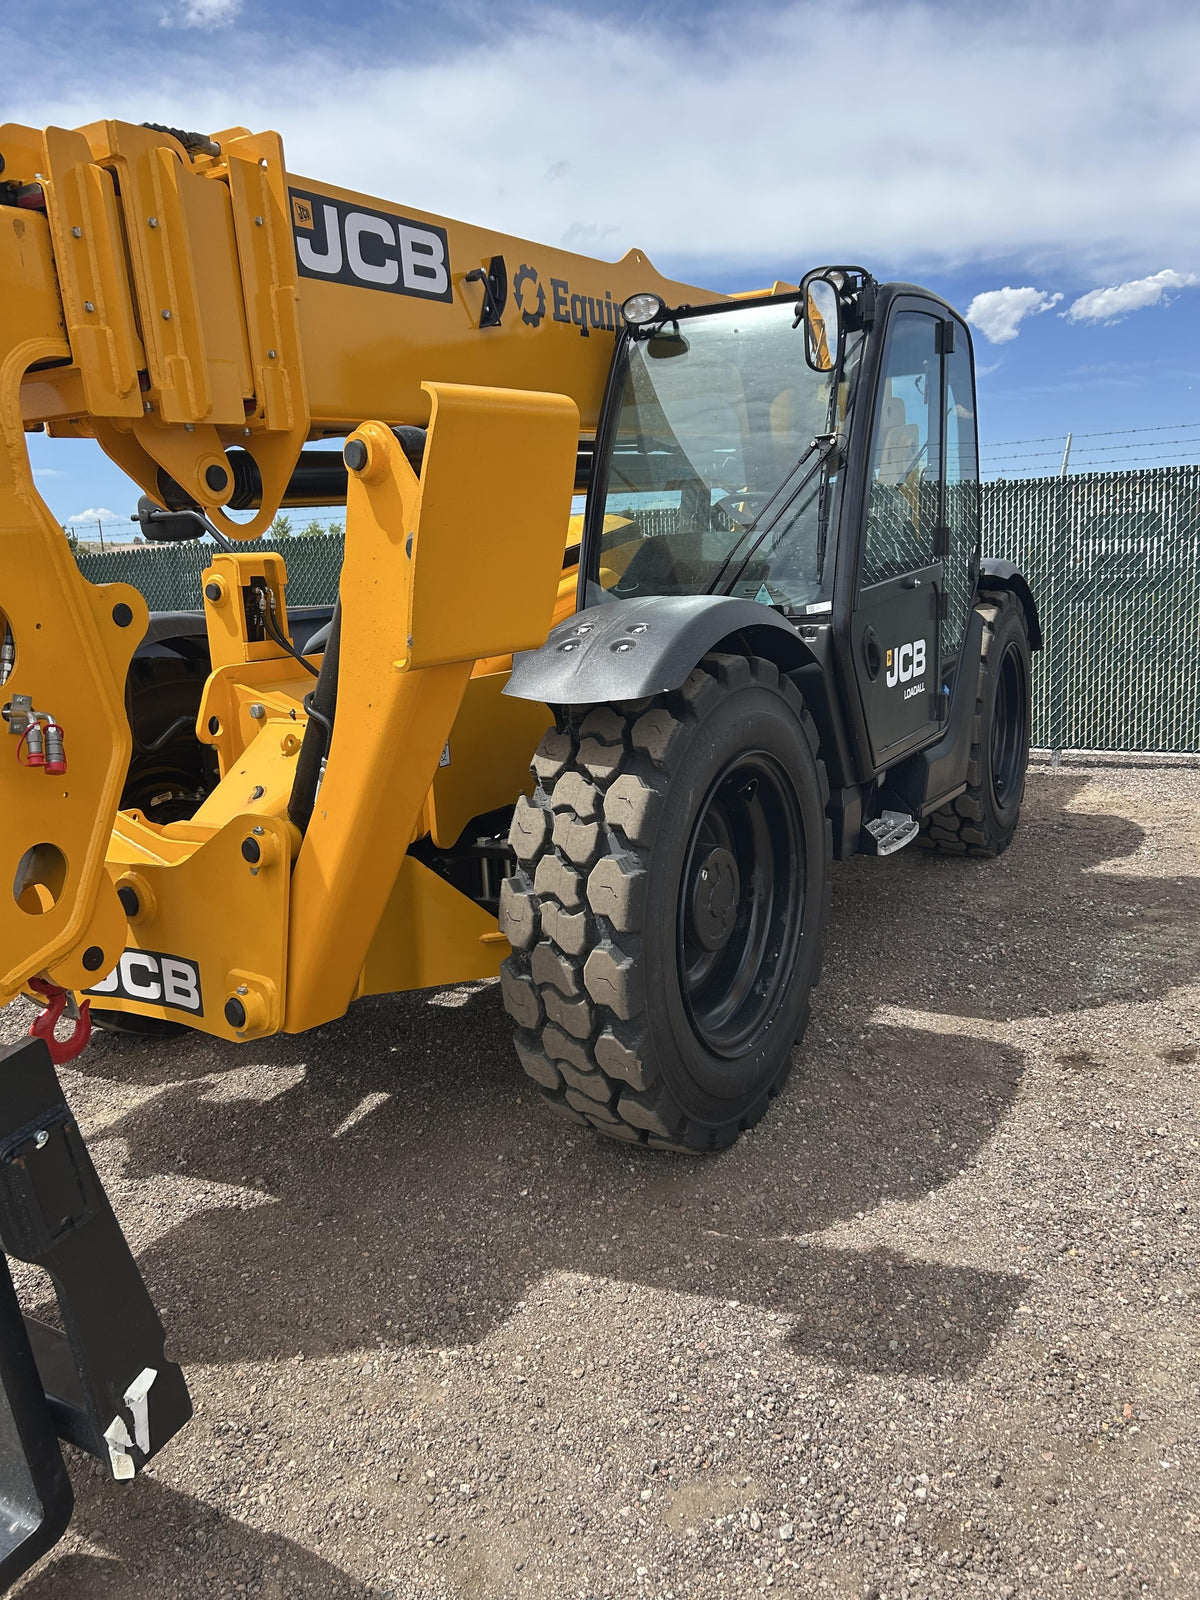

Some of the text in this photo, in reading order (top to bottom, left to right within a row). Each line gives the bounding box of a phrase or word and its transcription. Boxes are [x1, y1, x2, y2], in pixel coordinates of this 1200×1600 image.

[296, 204, 449, 294] JCB
[886, 639, 926, 688] JCB
[903, 682, 926, 700] LOADALL
